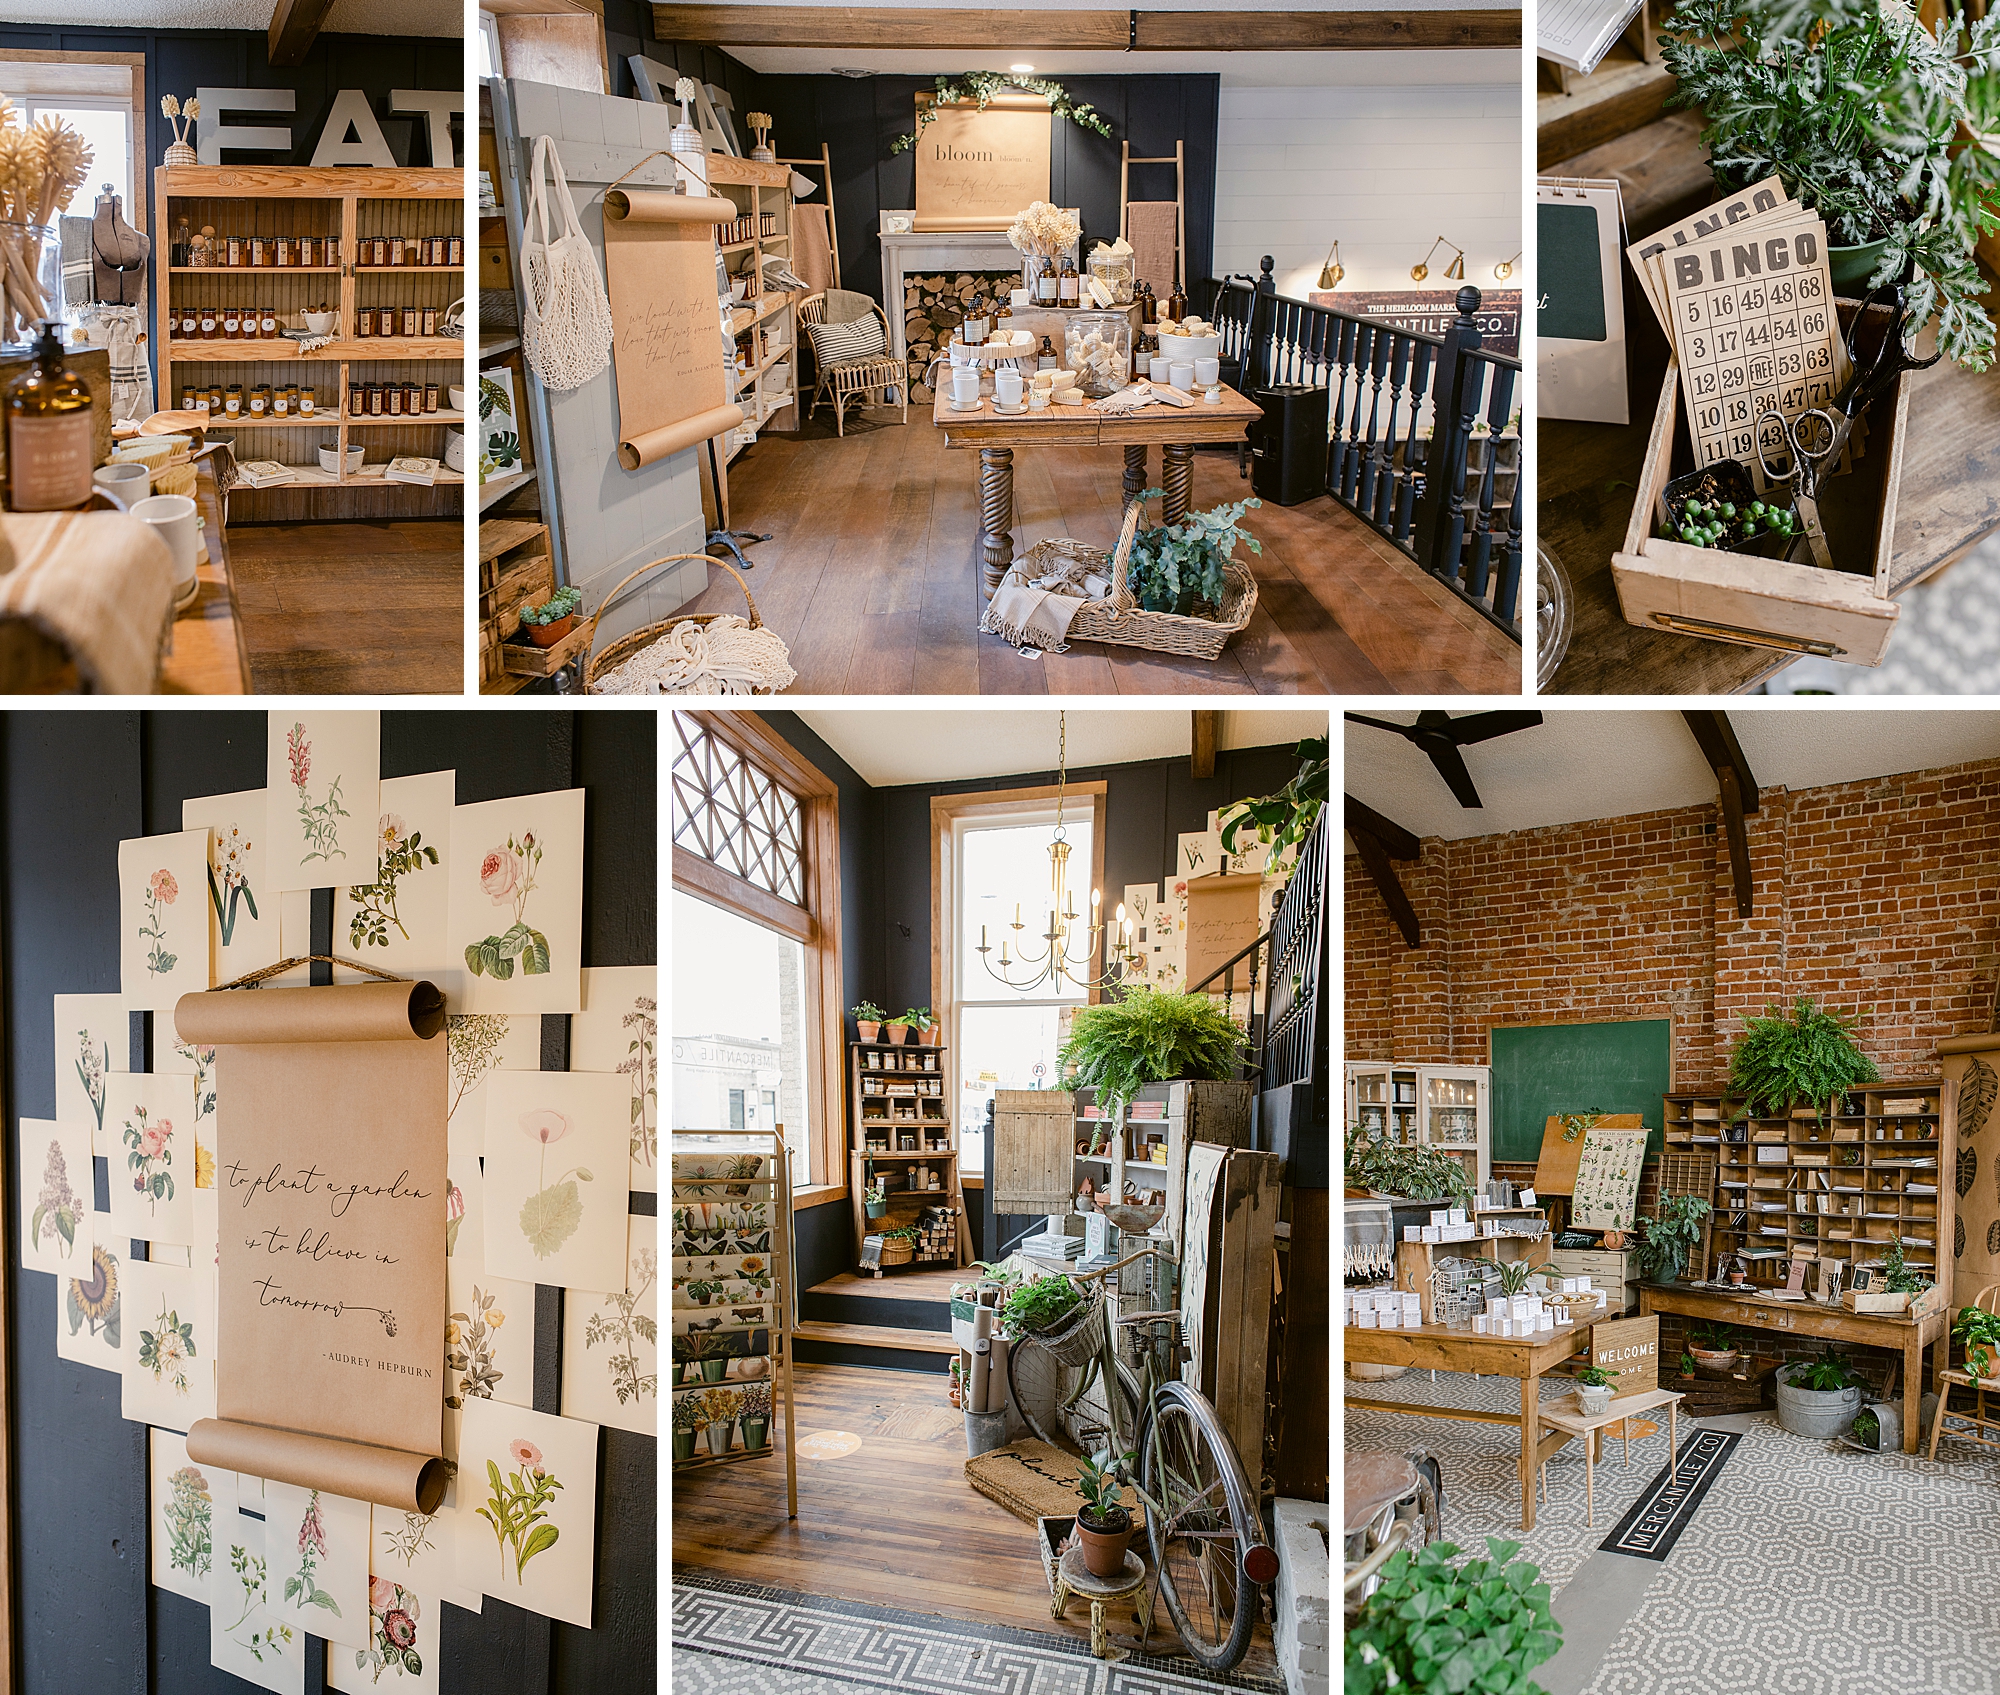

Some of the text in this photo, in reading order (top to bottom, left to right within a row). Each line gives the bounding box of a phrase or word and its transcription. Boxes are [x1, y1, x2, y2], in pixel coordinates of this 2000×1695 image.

[196, 87, 465, 168] EAT
[936, 145, 993, 161] bloom
[1674, 233, 1818, 290] BINGO
[629, 314, 644, 325] we
[645, 300, 675, 325] loved
[677, 298, 705, 319] with
[1367, 305, 1386, 313] THE
[1386, 303, 1430, 313] HEIRLOOM
[1688, 276, 1821, 322] 5 16 45 48 68
[621, 322, 715, 352] love that was more
[1477, 317, 1508, 332] CO.
[1693, 312, 1825, 358] 3 17 44 54 66
[645, 346, 668, 370] than
[1694, 347, 1830, 396] 12 29 FREE 53 63
[1699, 381, 1833, 429] 10 18 36 47 71
[1705, 440, 1726, 462] 11
[1731, 433, 1752, 455] 19
[1759, 426, 1783, 448] 43
[224, 1160, 432, 1218] to plant a garden
[245, 1226, 400, 1264] is to believe in
[253, 1275, 352, 1318] tomorrow
[377, 1360, 433, 1379] HEPBURN
[1599, 1342, 1656, 1364] WELCOME
[1620, 1365, 1643, 1376] OME
[992, 1452, 1080, 1488] plant
[1629, 1462, 1703, 1547] MERCANTILE
[1698, 1436, 1723, 1452] CO.
